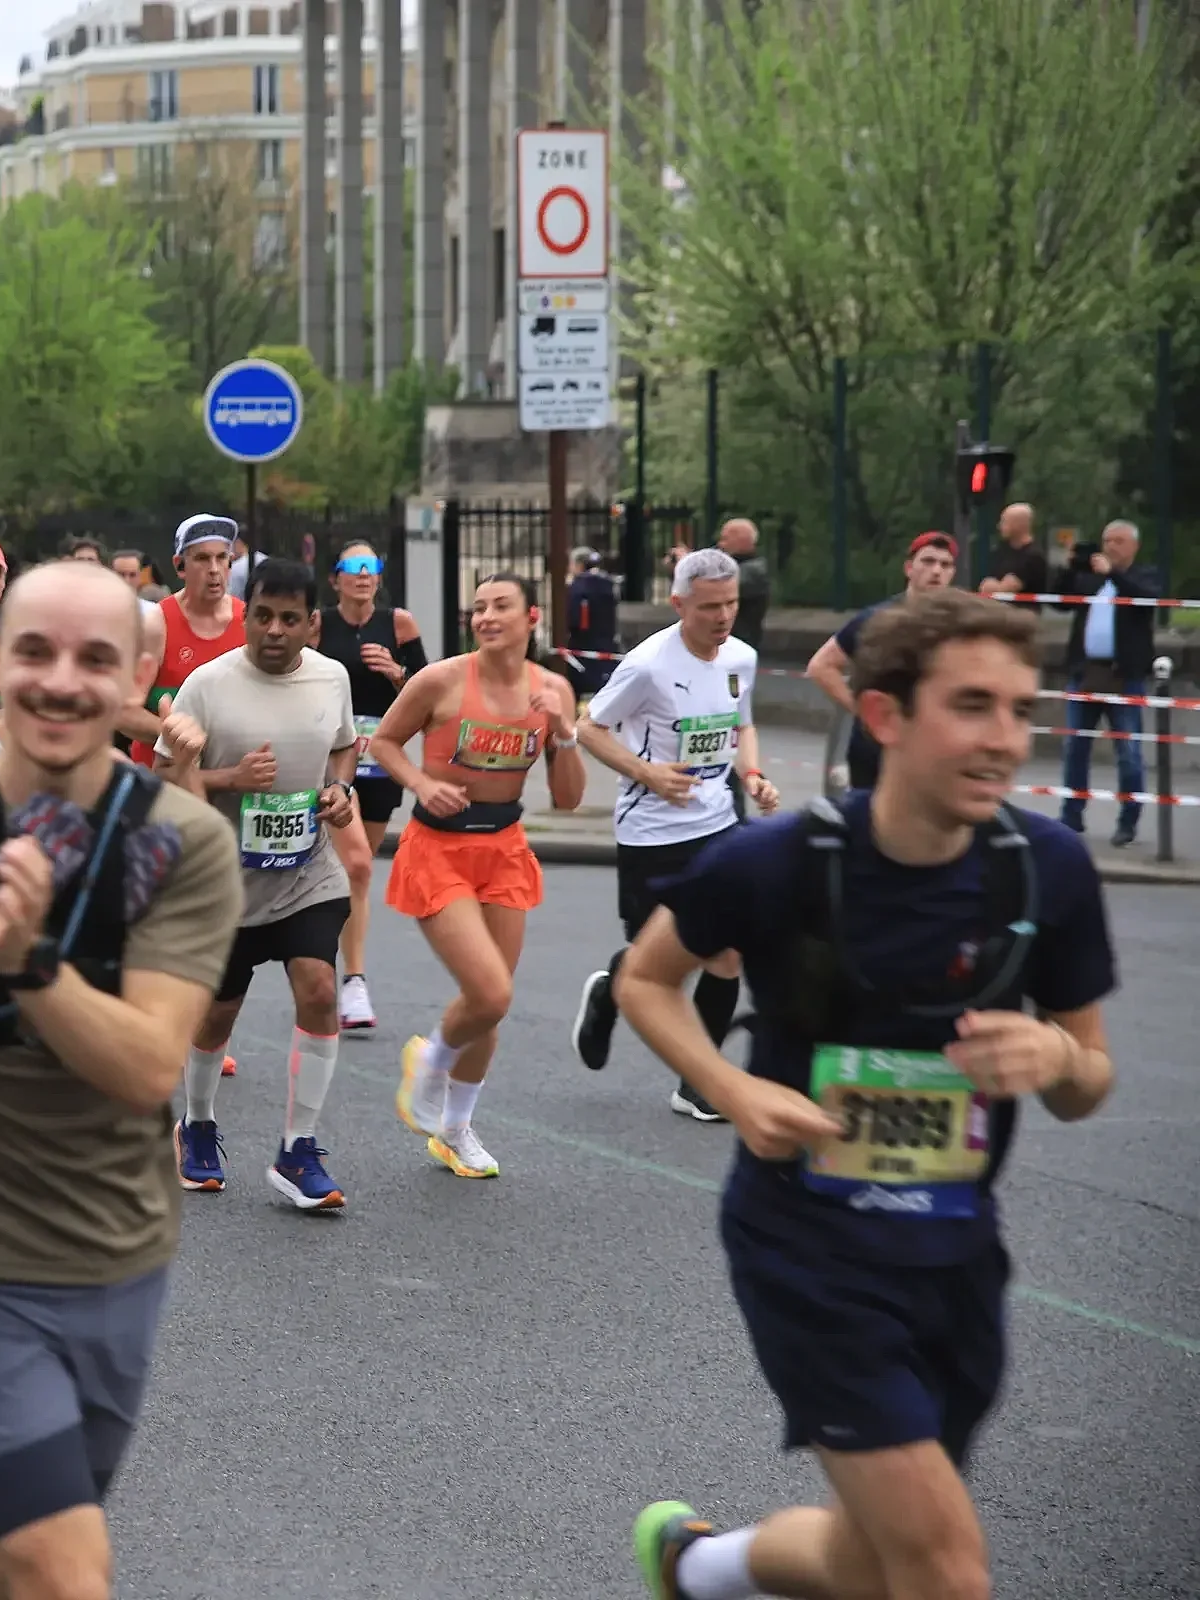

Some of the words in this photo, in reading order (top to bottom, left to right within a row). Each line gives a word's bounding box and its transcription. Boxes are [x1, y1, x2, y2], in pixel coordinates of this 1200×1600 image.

[537, 149, 588, 169] ZONE
[688, 732, 727, 753] 33237
[253, 813, 305, 838] 16355
